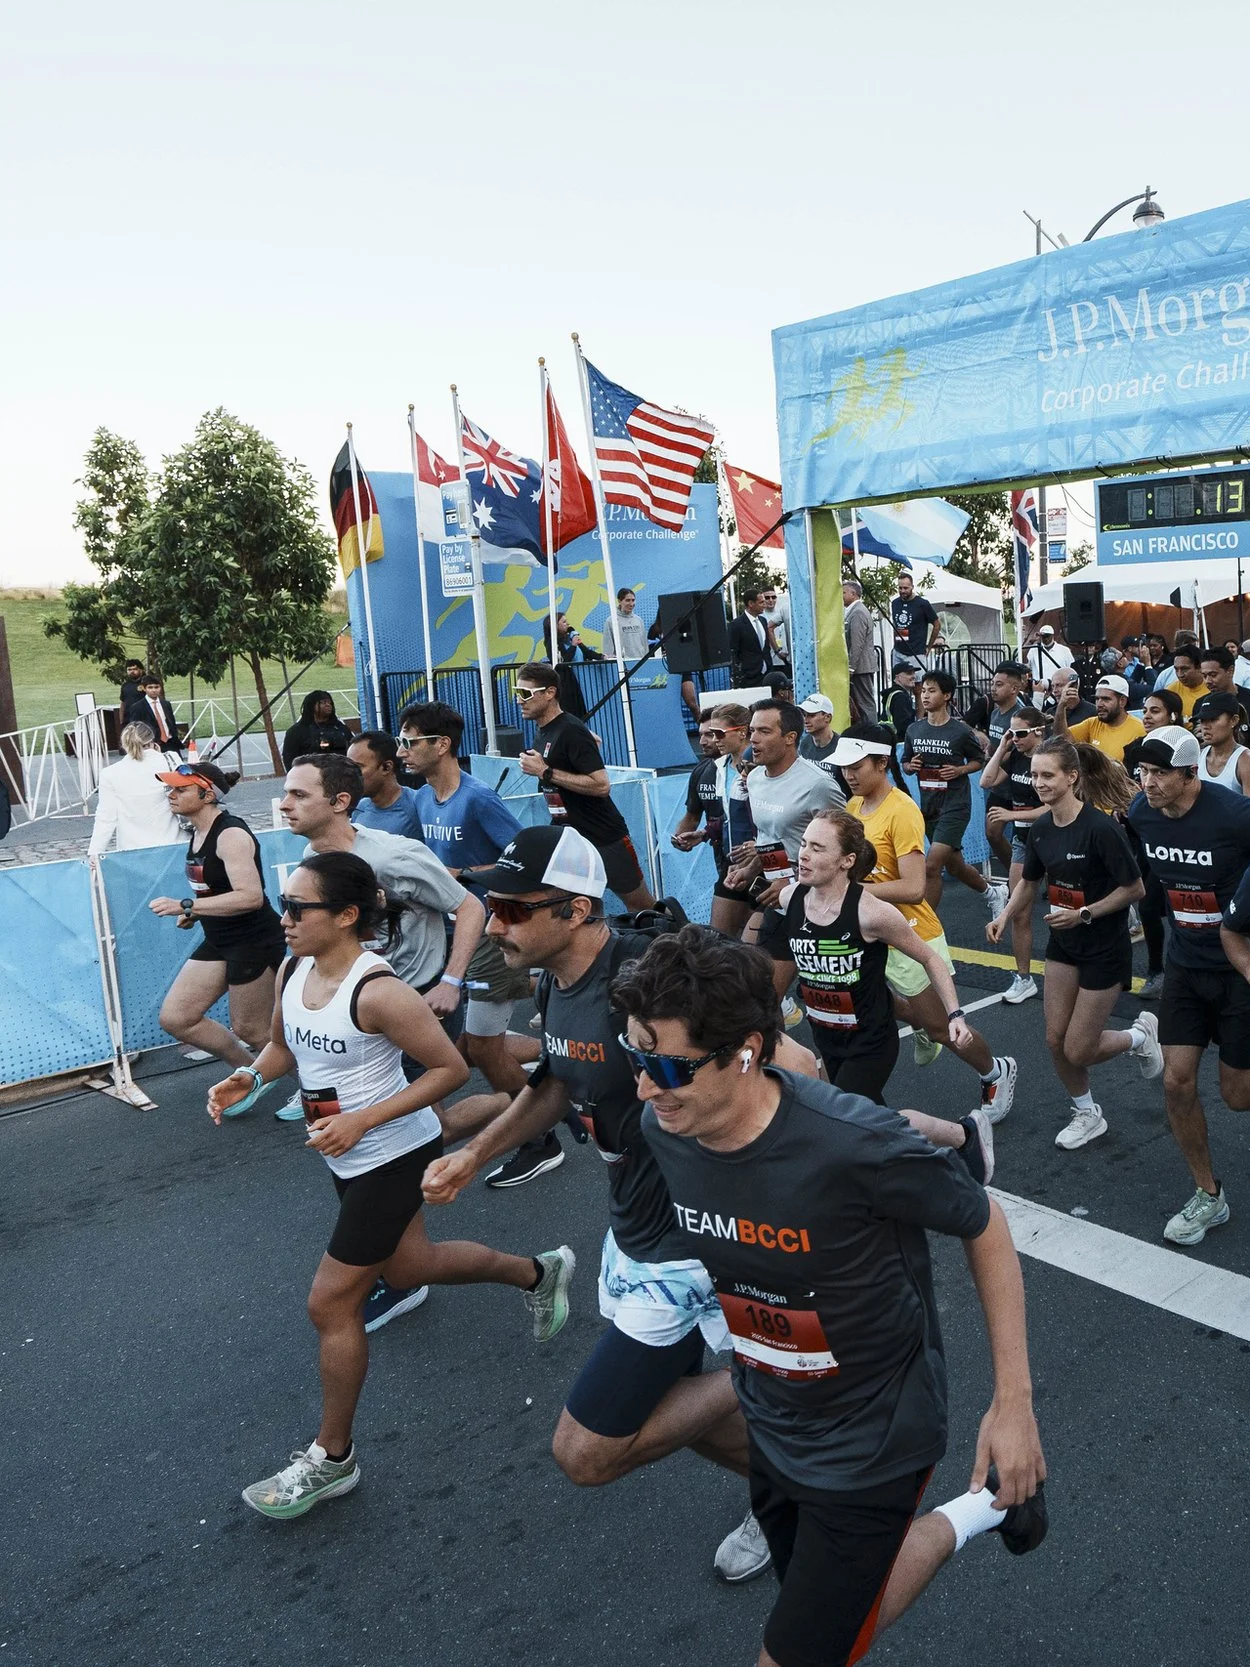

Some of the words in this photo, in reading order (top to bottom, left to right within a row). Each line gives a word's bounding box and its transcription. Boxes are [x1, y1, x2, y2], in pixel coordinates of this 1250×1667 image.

[1041, 373, 1168, 413] Corporate
[442, 545, 455, 555] Pay
[455, 544, 464, 554] by
[1113, 539, 1144, 557] SAN
[1149, 531, 1239, 554] FRANCISCO
[443, 555, 465, 564] License
[443, 564, 460, 574] Plate
[913, 739, 950, 748] FRANKLIN
[1146, 843, 1213, 867] Lonza
[838, 972, 858, 986] 1998
[295, 1027, 347, 1054] Meta
[673, 1202, 812, 1254] TEAMBCCI
[734, 1283, 788, 1305] J.P.Morgan
[745, 1304, 792, 1338] 189
